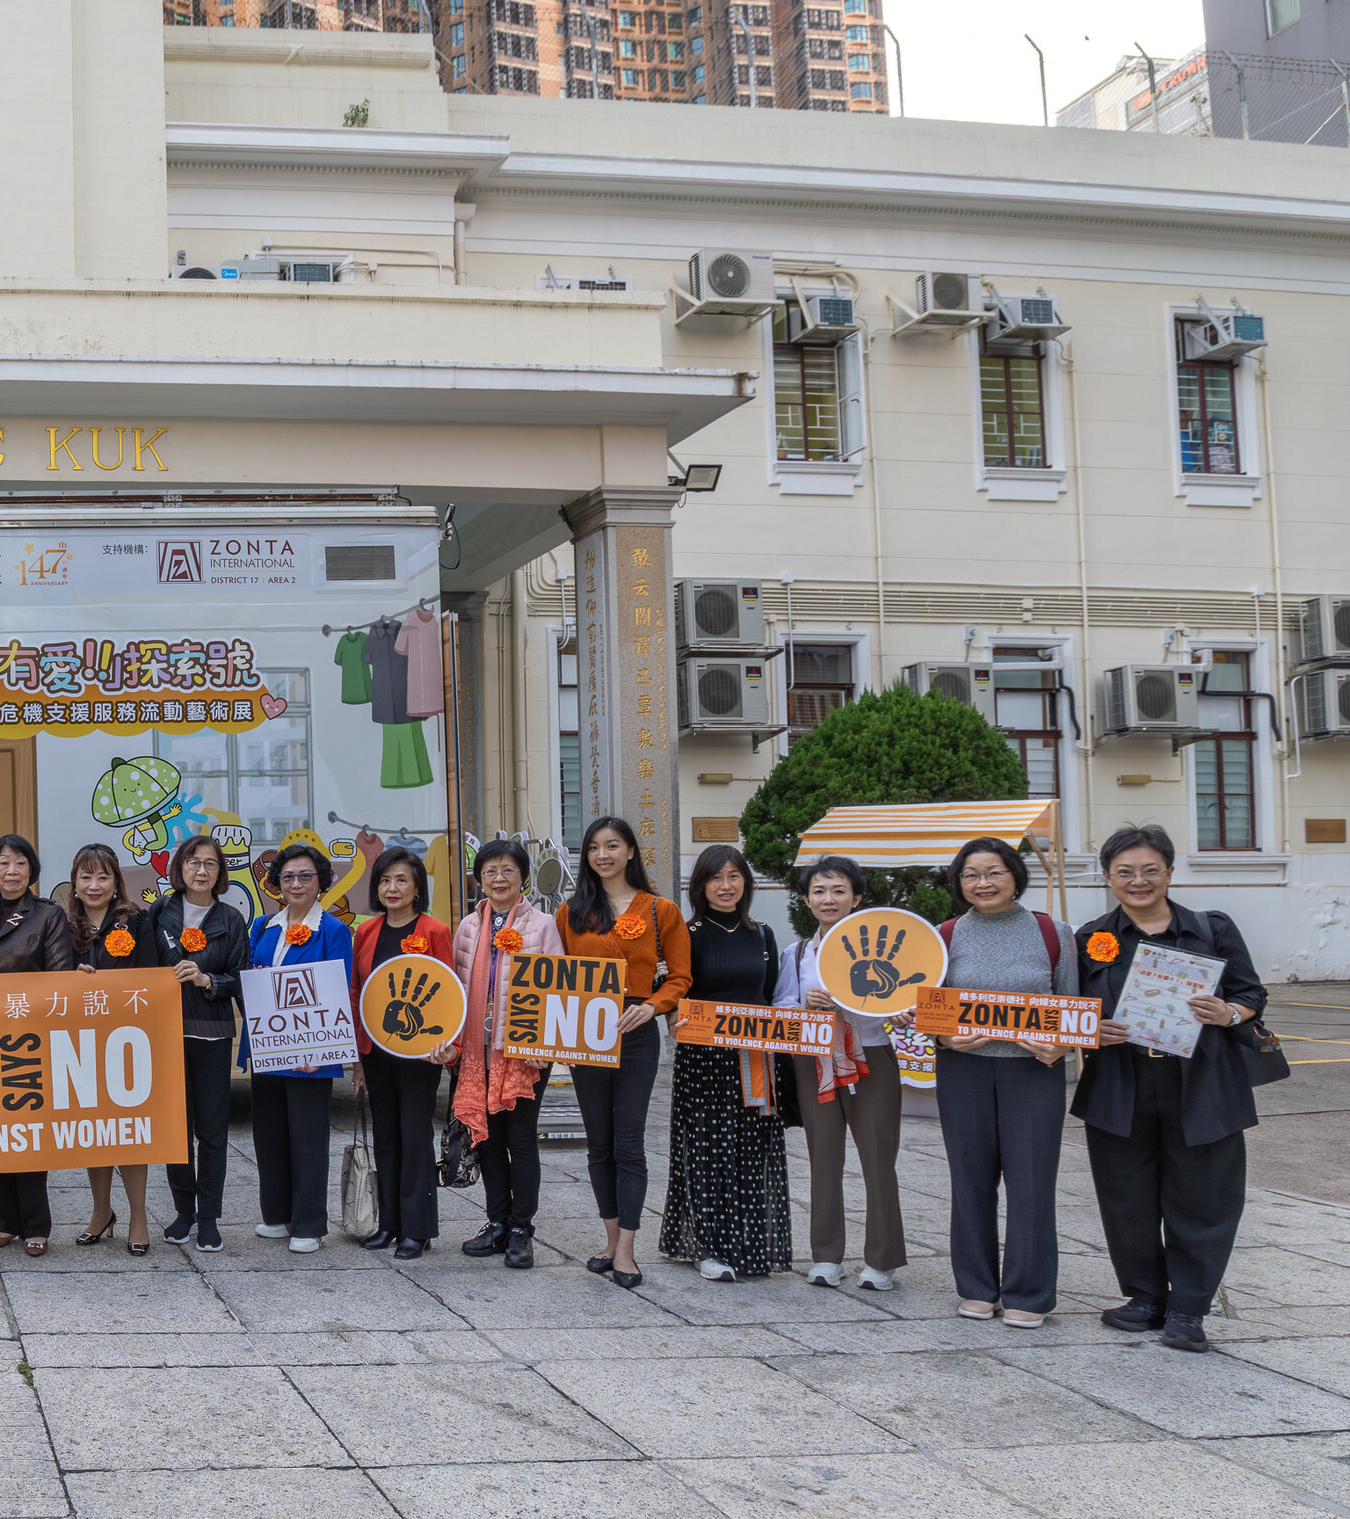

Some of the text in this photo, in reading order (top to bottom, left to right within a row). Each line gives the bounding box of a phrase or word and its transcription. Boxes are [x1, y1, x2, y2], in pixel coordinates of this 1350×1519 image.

[46, 427, 168, 471] KUK
[210, 539, 295, 555] ZONTA
[210, 558, 295, 568] INTERNATIONAL
[225, 858, 242, 866] eer
[511, 955, 621, 994] ZONTA
[508, 993, 540, 1043] SAYS
[918, 1002, 955, 1011] ZONTA
[957, 1002, 1098, 1035] ZONTA SAYS NO
[248, 1008, 351, 1035] ZONTA
[543, 994, 620, 1051] NO
[713, 1014, 785, 1041] ZONTA
[787, 1021, 800, 1042] SAYS
[801, 1022, 832, 1045] NO
[251, 1027, 353, 1049] INTERNATIONAL
[713, 1036, 724, 1045] TO
[725, 1037, 763, 1049] VIOLENCE
[764, 1041, 798, 1052] AGAINST
[800, 1044, 831, 1055] WOMEN
[957, 1026, 969, 1035] TO
[971, 1027, 1015, 1039] VIOLENCE
[1017, 1030, 1058, 1043] AGAINST
[1059, 1034, 1096, 1046] WOMEN
[254, 1049, 356, 1068] DISTRICT 17 AREA 2
[507, 1046, 618, 1063] TO VIOLENCE AGAINST WOMEN
[0, 1032, 45, 1111] SAYS
[49, 1025, 152, 1110] NO
[51, 1116, 152, 1149] WOMEN
